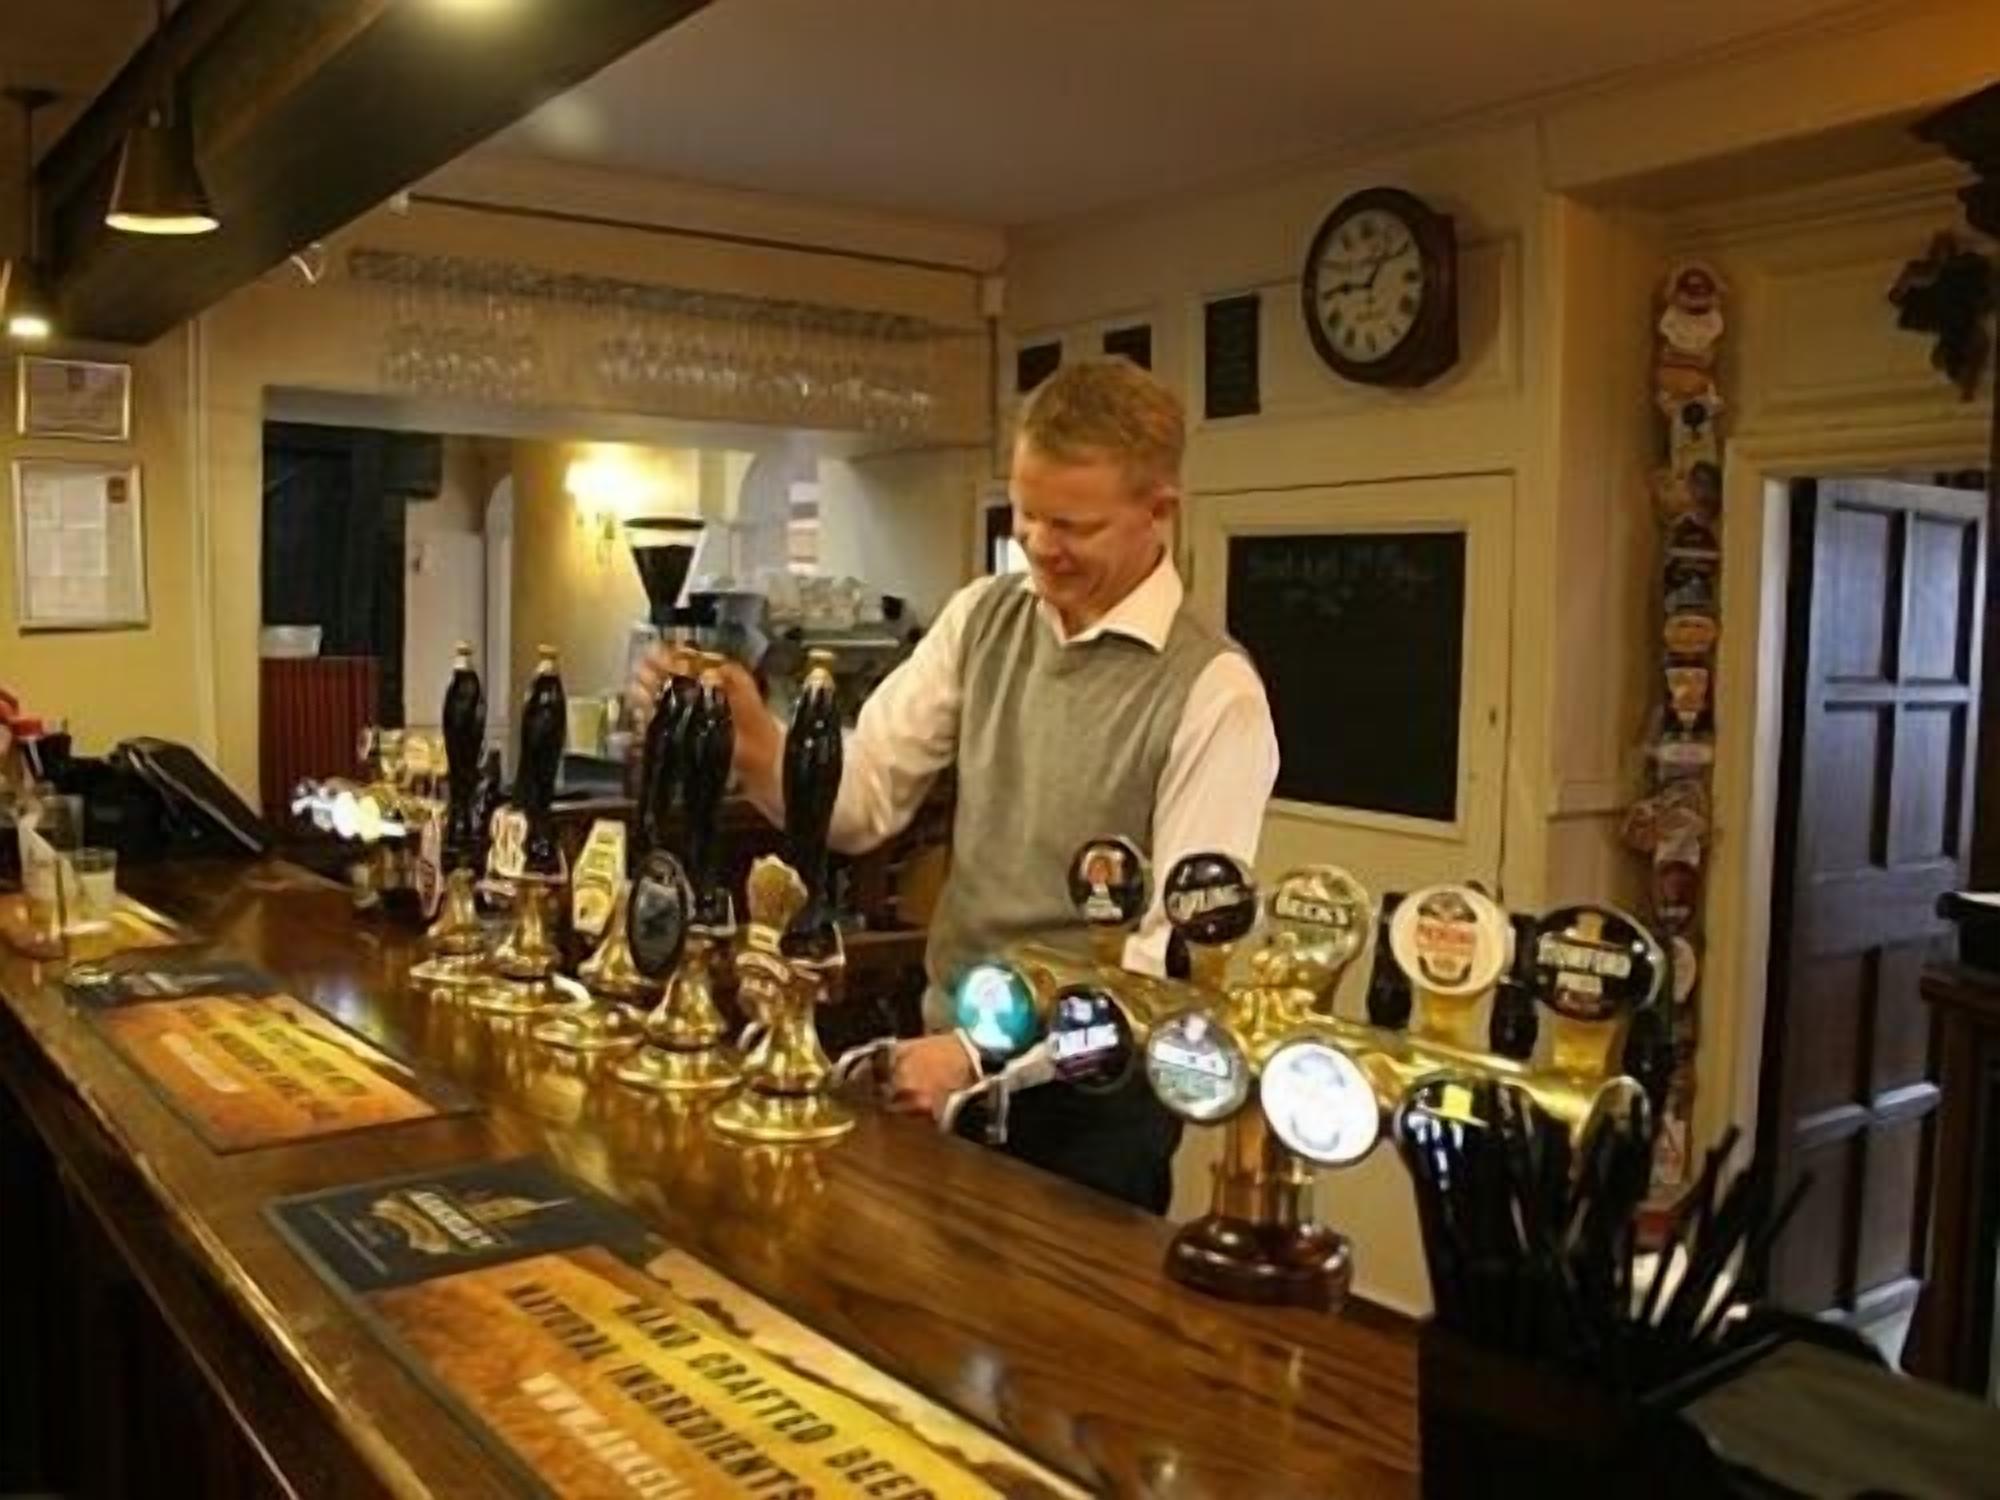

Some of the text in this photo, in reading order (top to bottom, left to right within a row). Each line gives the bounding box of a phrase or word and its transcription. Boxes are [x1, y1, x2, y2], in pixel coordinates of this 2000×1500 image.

[505, 1280, 622, 1363] NATURAL
[613, 1301, 701, 1350] HAND
[687, 1351, 837, 1444] CRAFTED
